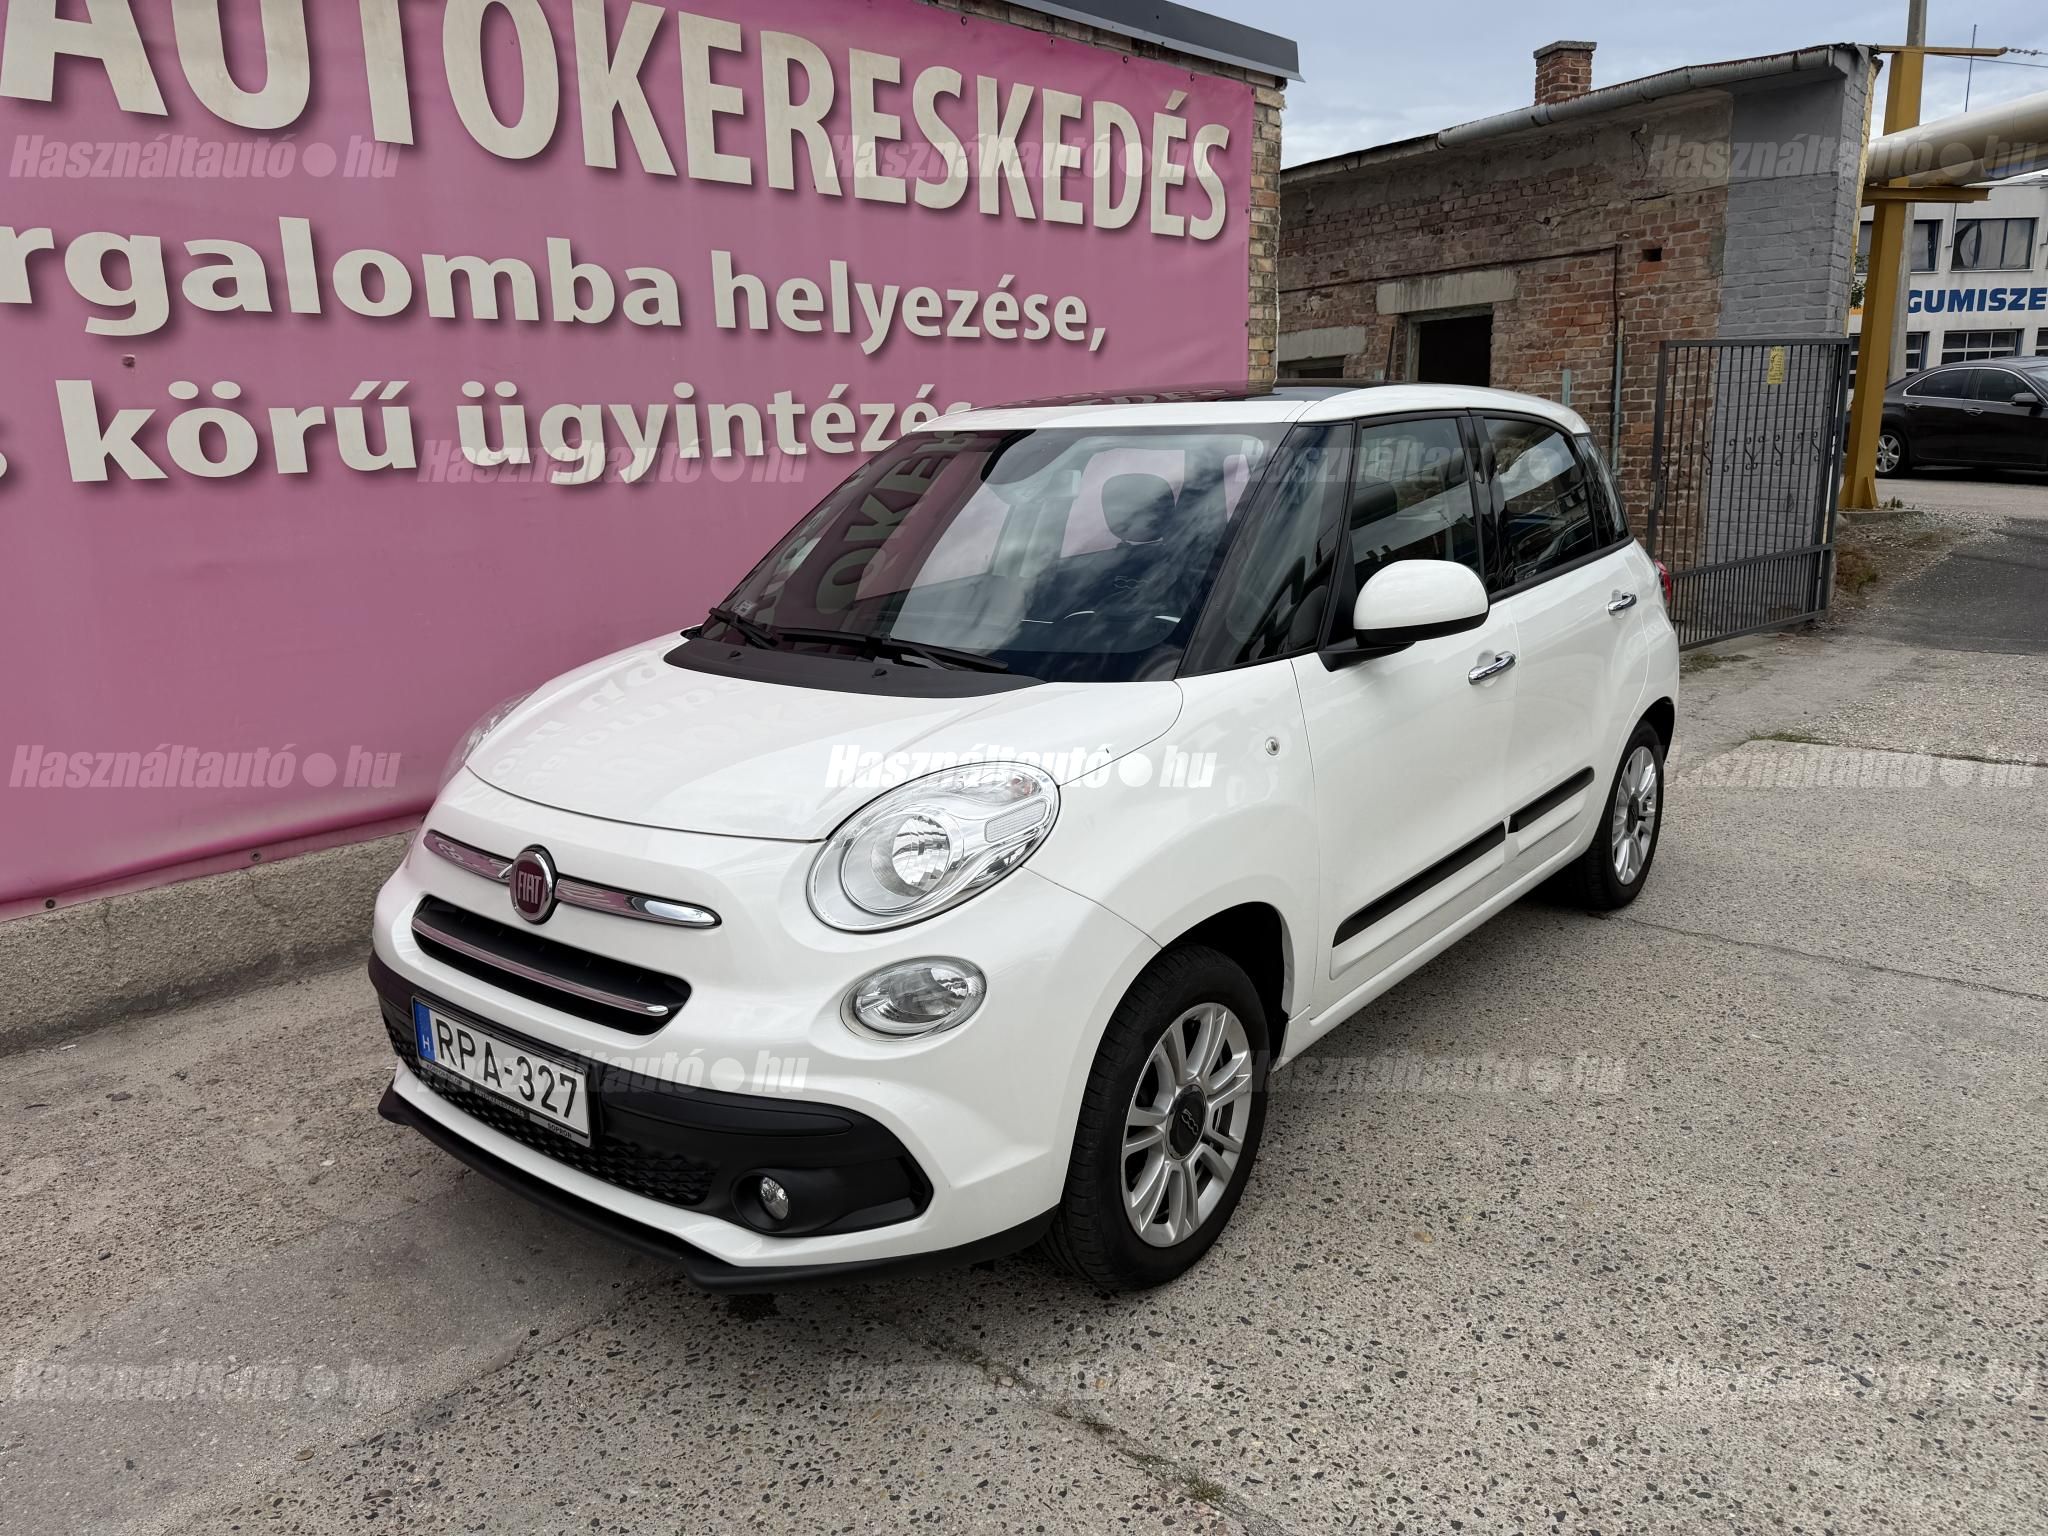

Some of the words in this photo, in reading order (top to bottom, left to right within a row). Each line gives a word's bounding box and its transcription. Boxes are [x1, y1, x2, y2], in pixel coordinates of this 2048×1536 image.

[711, 250, 1106, 354] helyezése,
[55, 380, 418, 482] körű
[456, 381, 972, 485] ügyintézé
[517, 870, 542, 904] FIAT
[435, 1018, 578, 1118] RPA-327
